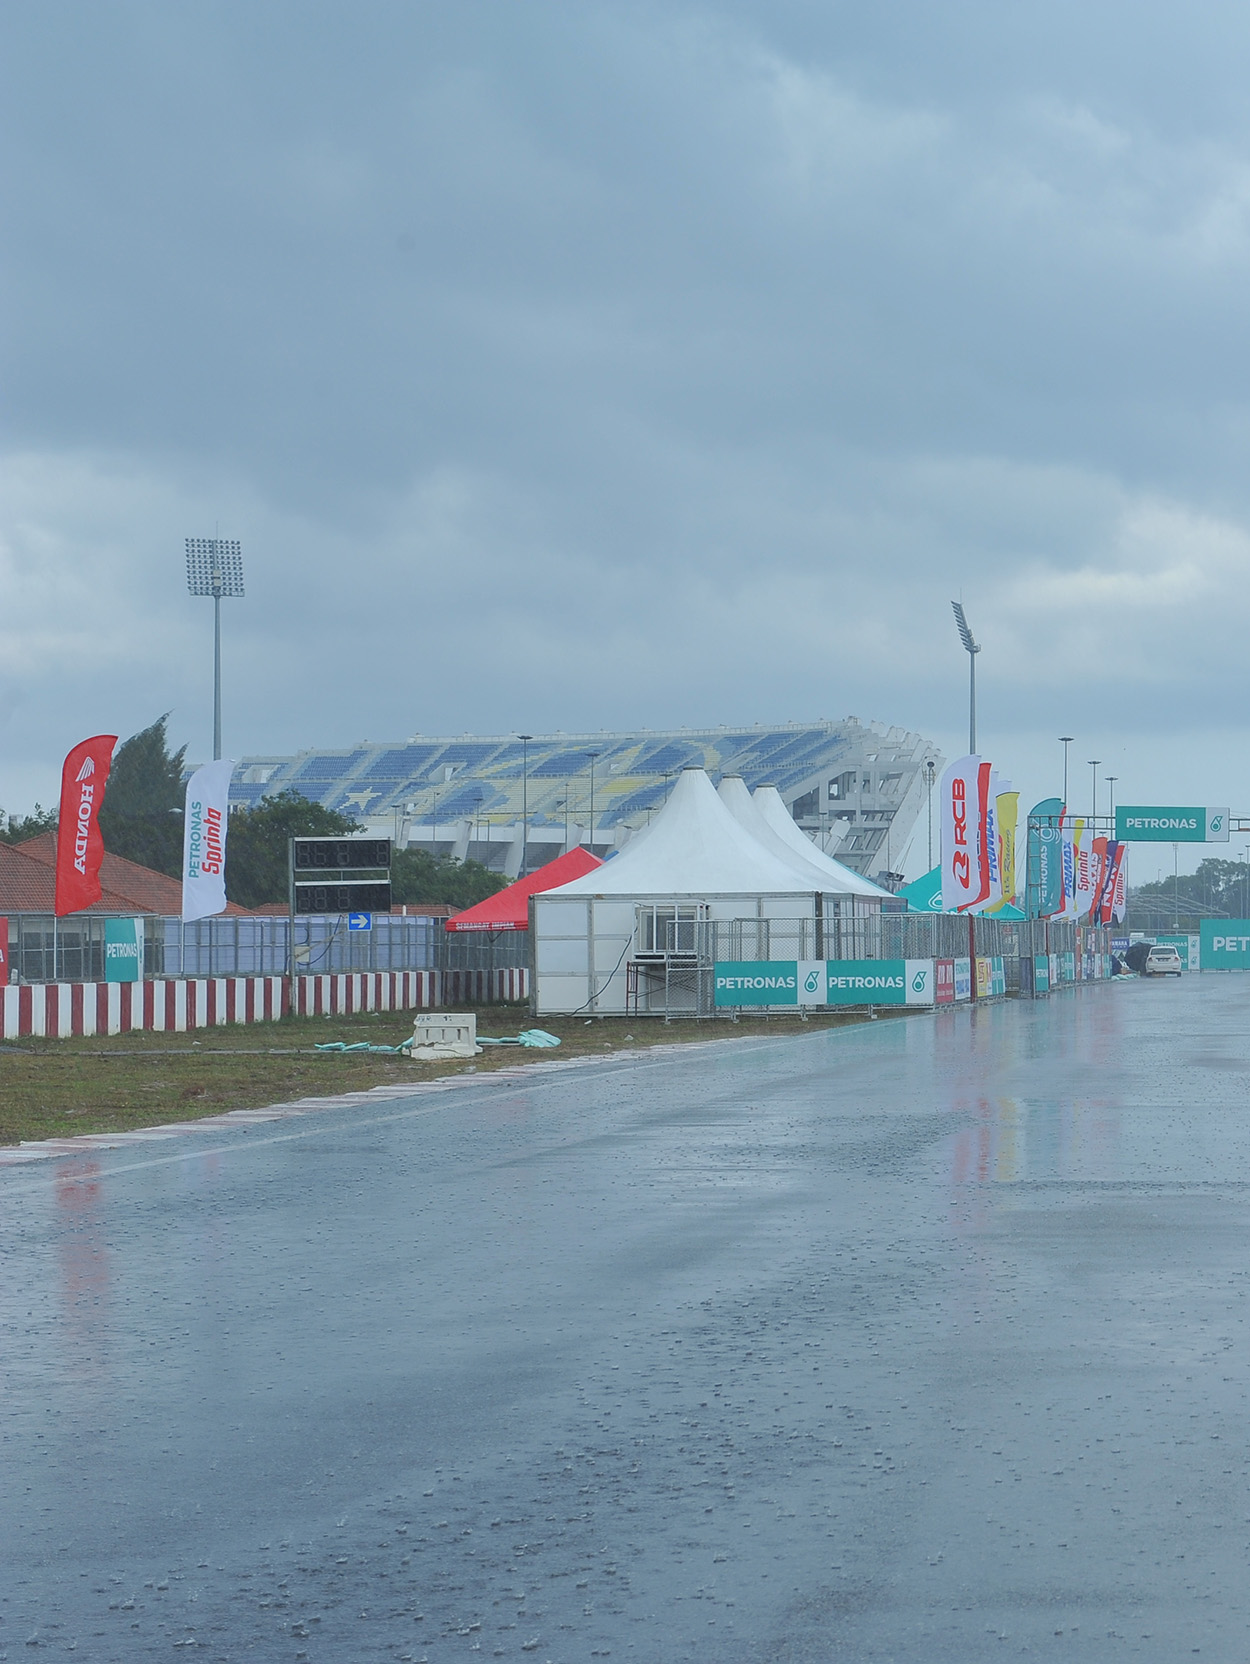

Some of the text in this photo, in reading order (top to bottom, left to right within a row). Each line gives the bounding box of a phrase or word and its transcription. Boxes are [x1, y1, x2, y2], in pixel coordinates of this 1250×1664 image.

[952, 778, 967, 845] RCB
[1126, 817, 1197, 829] PETRONAS
[188, 801, 202, 878] PETRONAS
[202, 807, 222, 875] Sprinta
[1063, 841, 1072, 898] PRIMAX
[1077, 851, 1089, 891] Sprinta
[106, 943, 138, 958] PETRONAS
[716, 976, 796, 989] PETRONAS
[828, 976, 904, 988] PETRONAS
